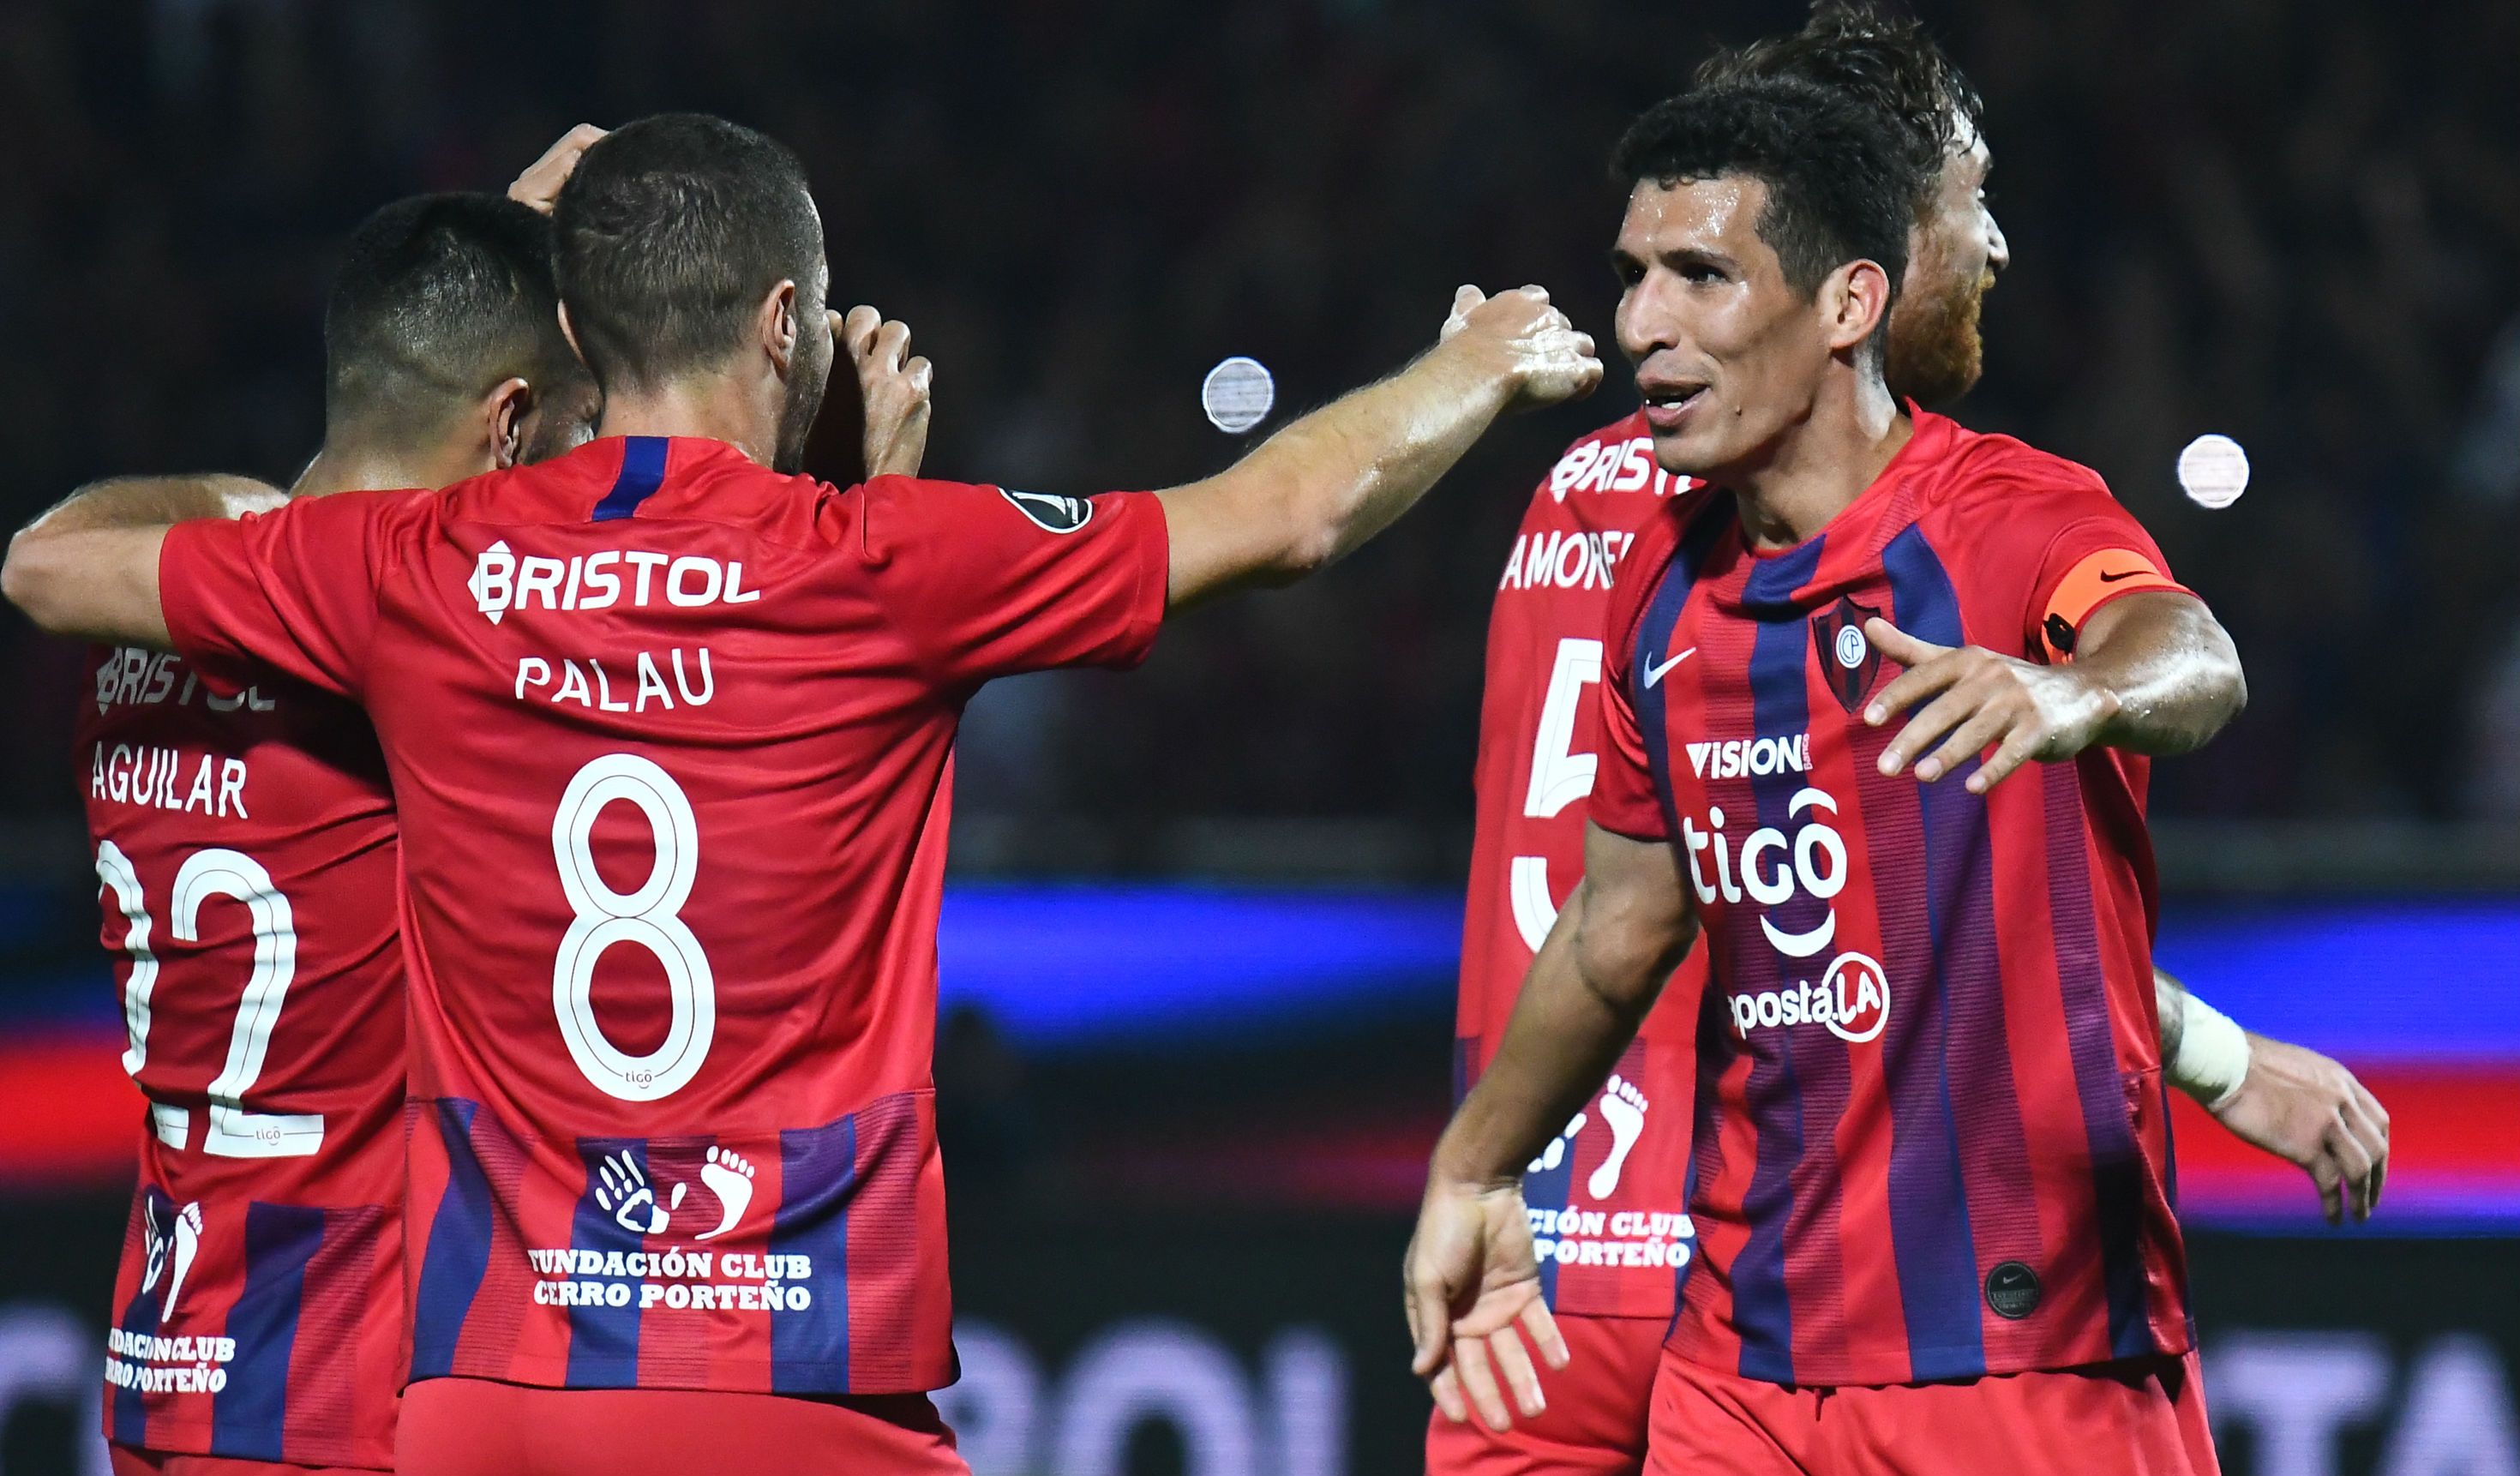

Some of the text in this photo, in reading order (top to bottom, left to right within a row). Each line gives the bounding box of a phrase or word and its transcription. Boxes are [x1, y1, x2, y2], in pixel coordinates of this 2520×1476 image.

[467, 540, 760, 626] BRISTOL
[96, 647, 275, 717] BRISL
[514, 647, 714, 713] PALAU
[92, 741, 248, 819] AGUILAR
[1683, 788, 1848, 957] tigo
[551, 752, 717, 1102] 8
[527, 1246, 813, 1280] FUNDACIÓN CLUB
[533, 1279, 812, 1311] CERRO PORTEÑO
[171, 1335, 236, 1362] CLUB
